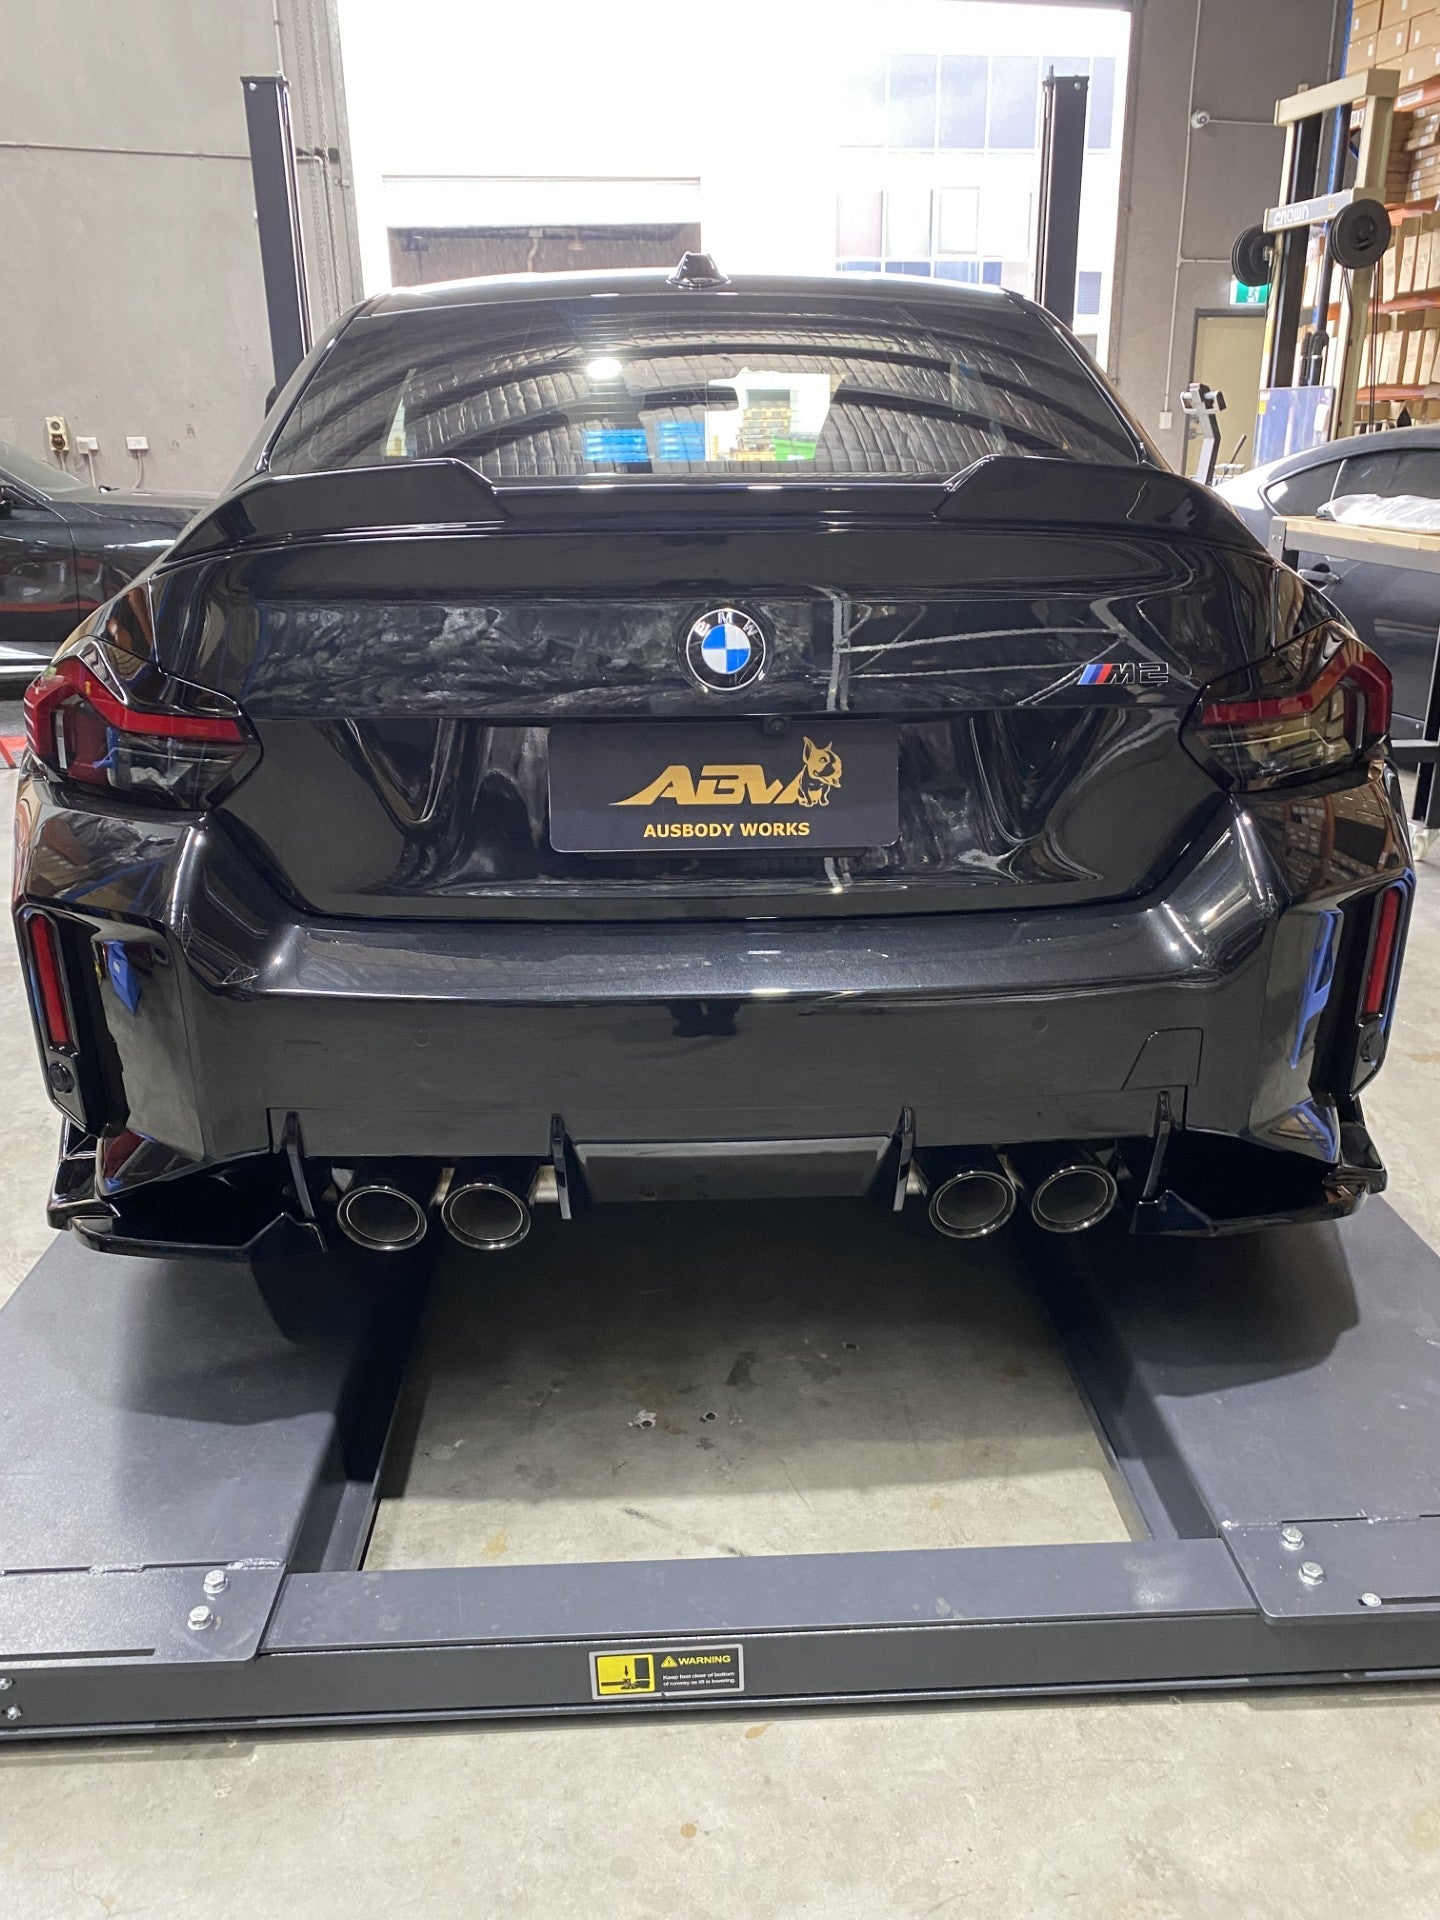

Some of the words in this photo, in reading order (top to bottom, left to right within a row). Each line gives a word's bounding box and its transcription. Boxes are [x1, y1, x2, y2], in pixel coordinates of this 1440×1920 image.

[1273, 205, 1309, 225] CROWN
[693, 611, 759, 637] BMW
[1098, 661, 1169, 685] M2
[643, 823, 734, 838] AUSBODY
[739, 822, 810, 837] WORKS
[678, 1655, 731, 1666] WARNING
